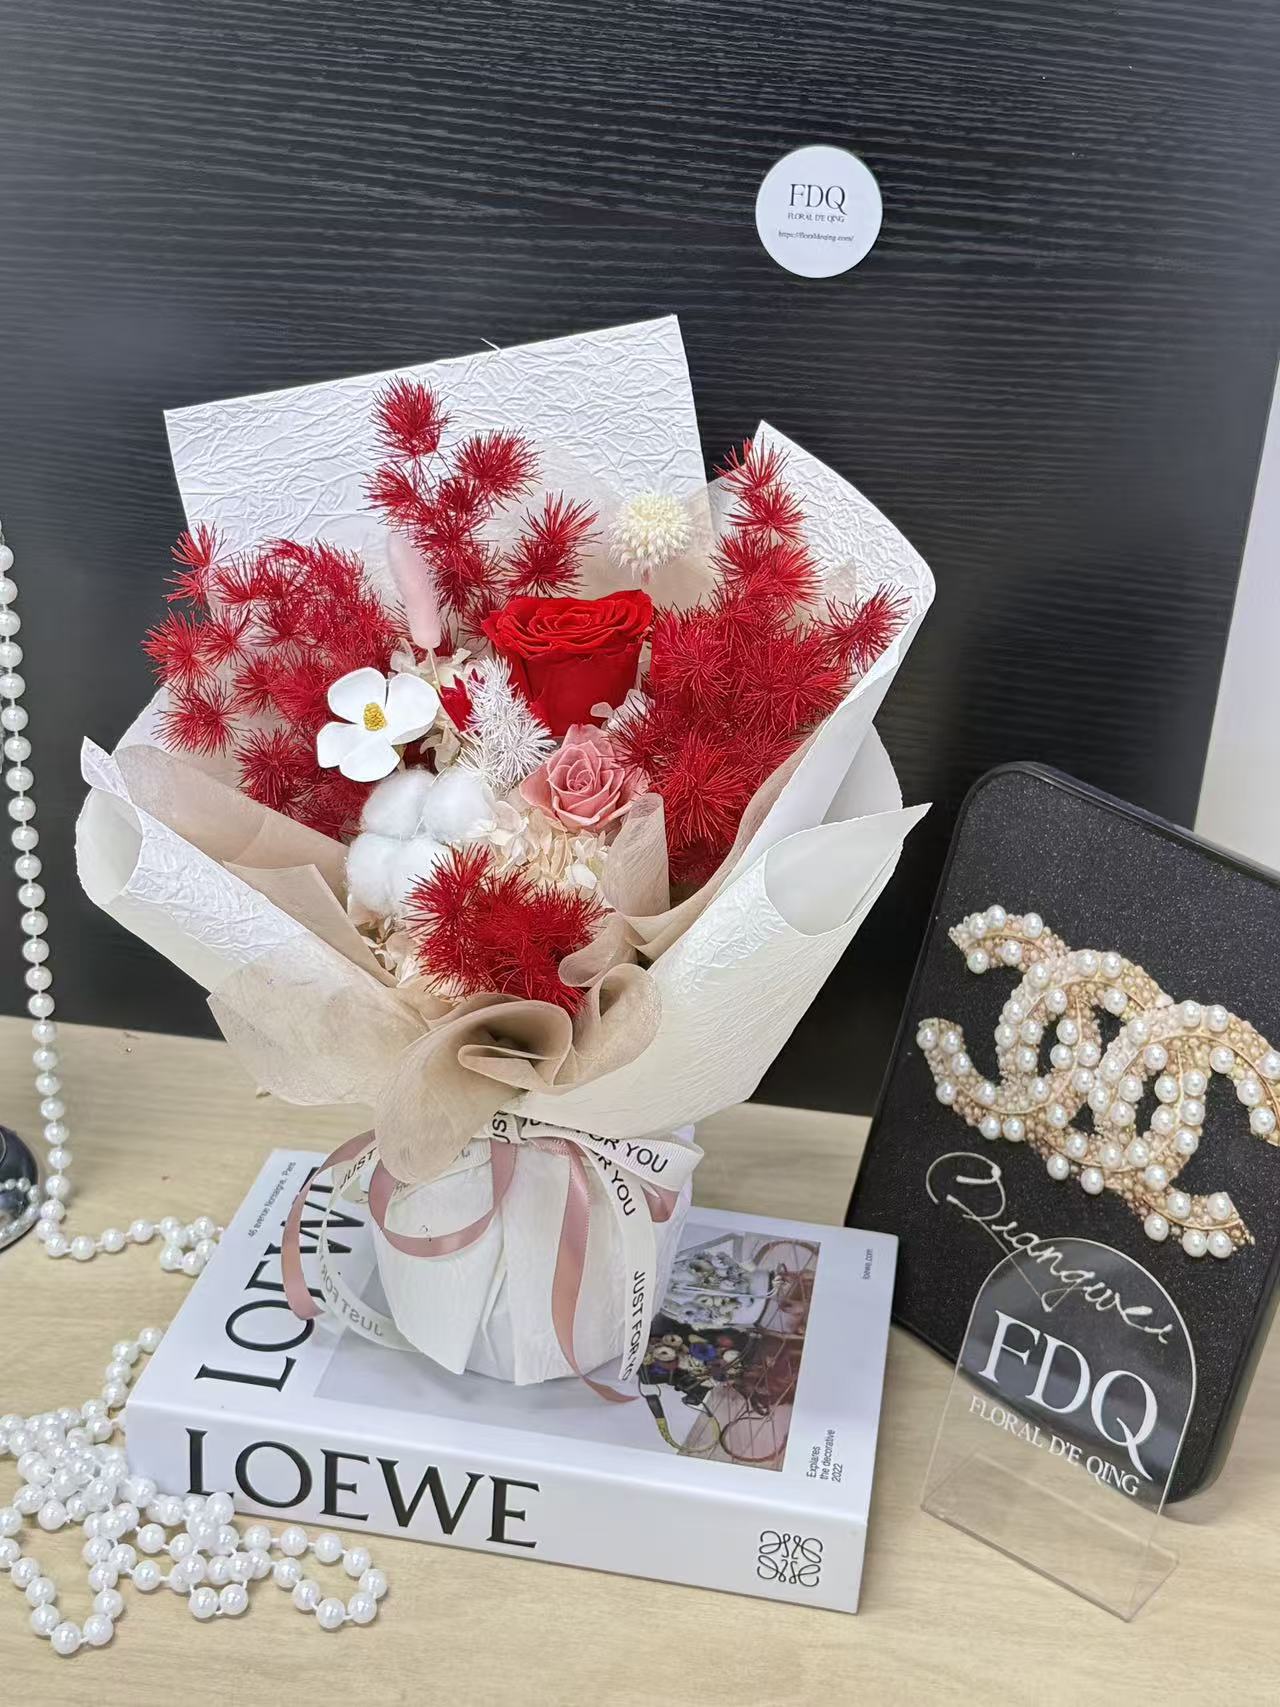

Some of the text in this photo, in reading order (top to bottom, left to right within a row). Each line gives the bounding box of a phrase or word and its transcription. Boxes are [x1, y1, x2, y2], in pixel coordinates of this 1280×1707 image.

[788, 212, 813, 221] FLORAL
[789, 183, 847, 215] FDQ
[339, 1146, 378, 1189] JUST
[625, 1142, 668, 1174] YOU
[610, 1169, 637, 1217] YOU
[633, 1271, 646, 1317] JUST
[978, 1310, 1158, 1481] FDQ
[819, 1429, 836, 1480] the decorative
[968, 1395, 1043, 1449] FLORAL
[1085, 1455, 1140, 1496] QING
[185, 1427, 540, 1549] LOEWE
[831, 1462, 843, 1483] 2022
